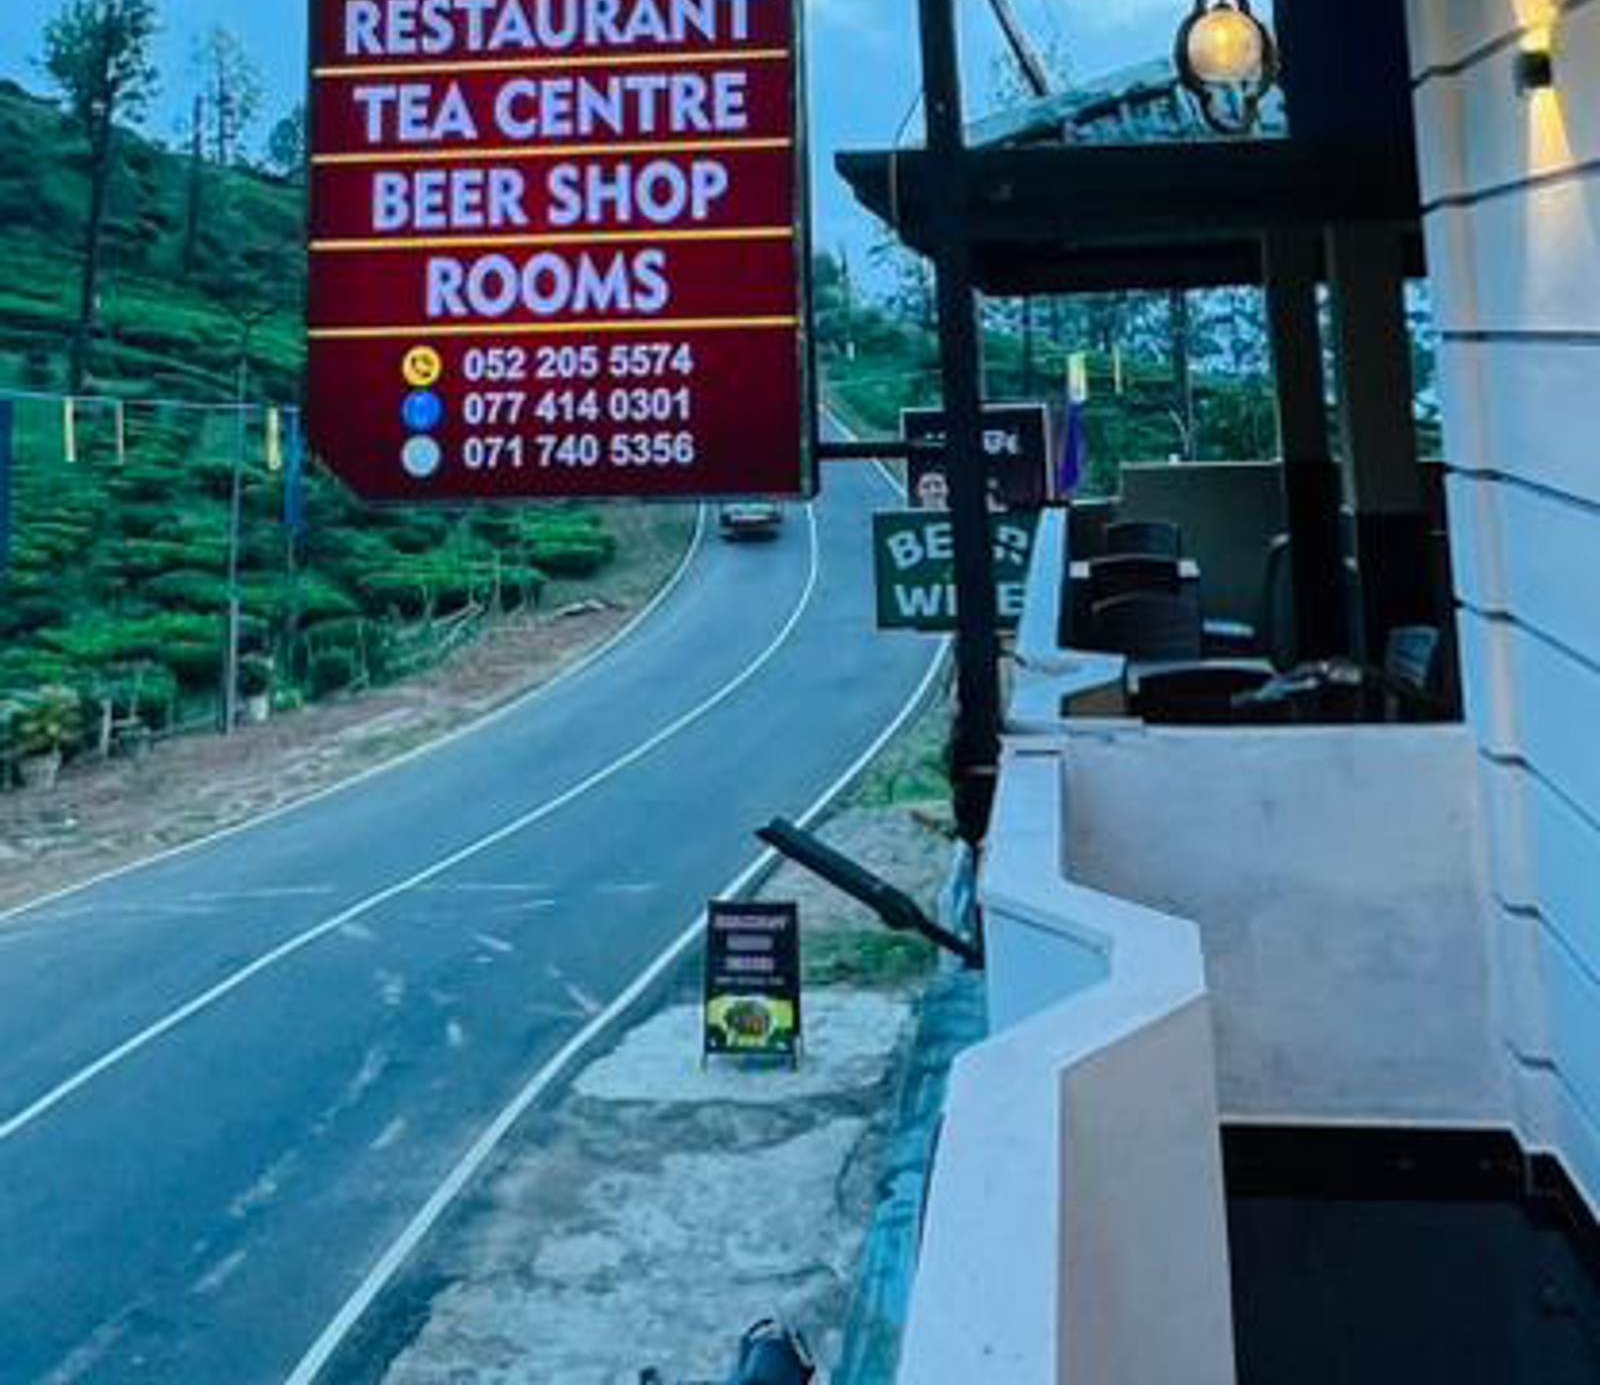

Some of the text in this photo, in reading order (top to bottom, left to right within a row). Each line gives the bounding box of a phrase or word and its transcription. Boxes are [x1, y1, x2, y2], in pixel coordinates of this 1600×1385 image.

[353, 72, 748, 142] TEA CENTRE
[372, 160, 728, 229] BEER SHOP
[425, 248, 669, 316] ROOMS
[463, 344, 693, 380] 052 205 5574
[463, 389, 692, 425] 077 414 0301
[463, 433, 694, 469] 071 740 5356
[887, 522, 1029, 570] BER
[894, 582, 1026, 617] WIE
